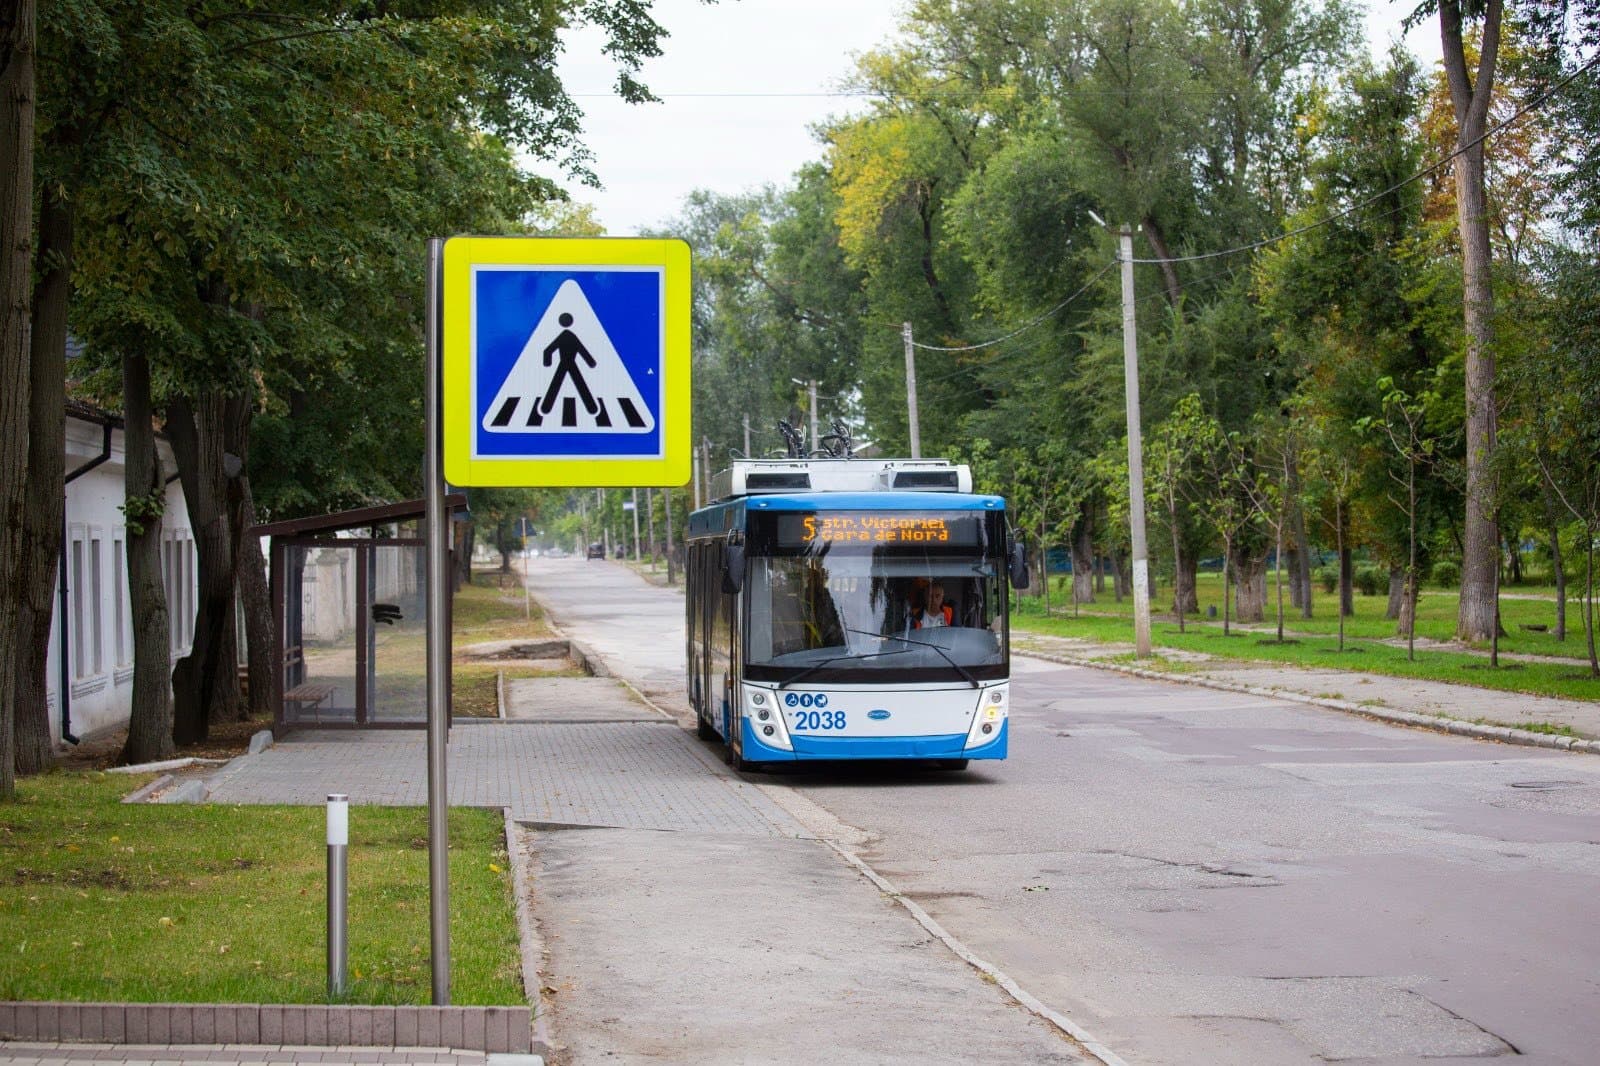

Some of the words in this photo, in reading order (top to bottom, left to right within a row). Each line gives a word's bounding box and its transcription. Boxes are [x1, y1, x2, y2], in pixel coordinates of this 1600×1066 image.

[803, 516, 815, 541] 5
[821, 530, 870, 541] Gara
[874, 530, 897, 541] de
[901, 530, 948, 541] Nord
[795, 711, 846, 730] 2038
